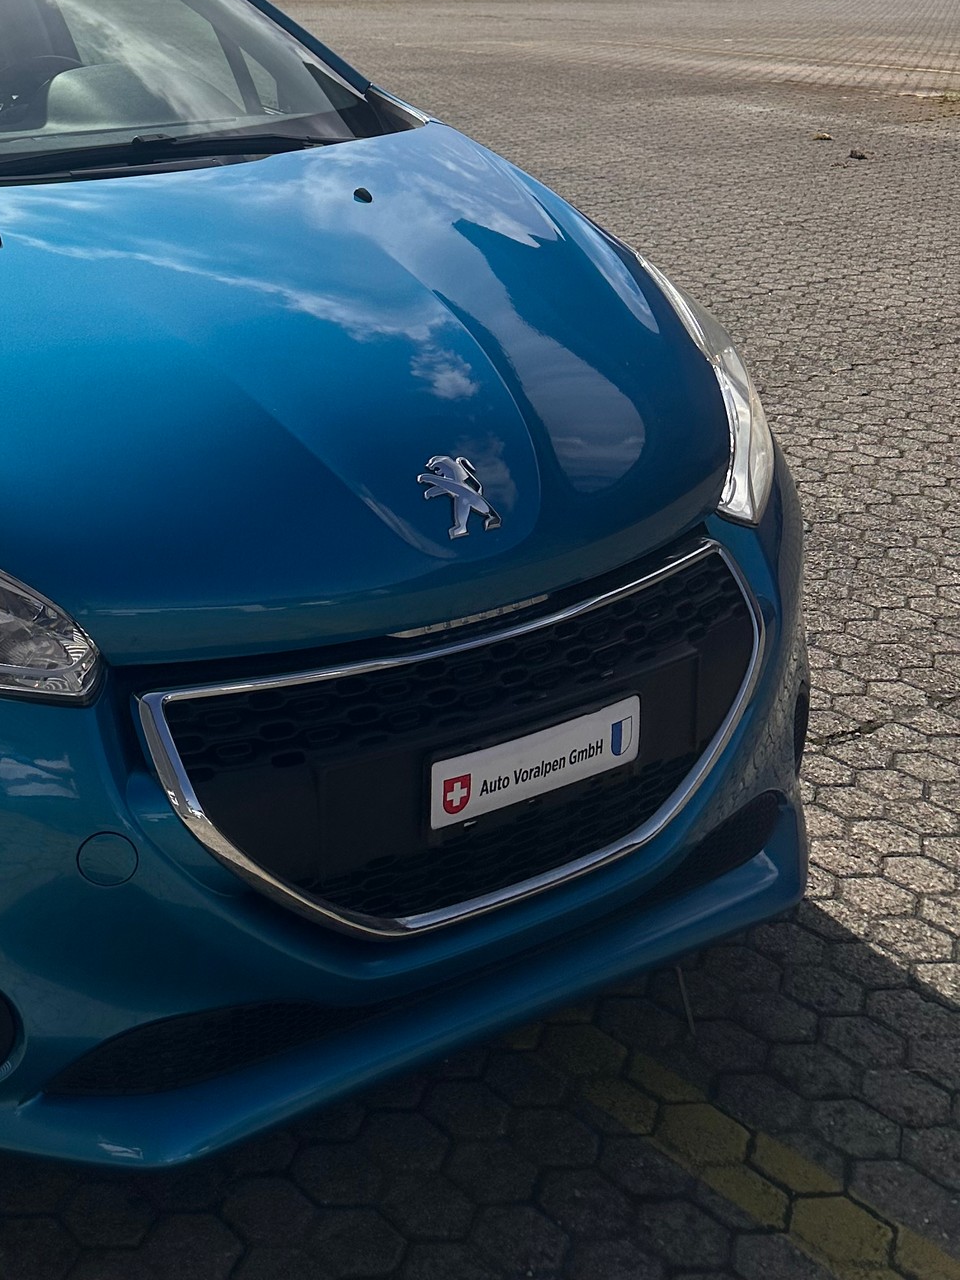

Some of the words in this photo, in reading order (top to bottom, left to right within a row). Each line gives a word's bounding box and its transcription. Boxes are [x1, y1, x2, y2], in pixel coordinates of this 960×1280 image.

[480, 776, 509, 796] Auto
[514, 757, 566, 784] Voralpen
[569, 739, 603, 765] GmbH
